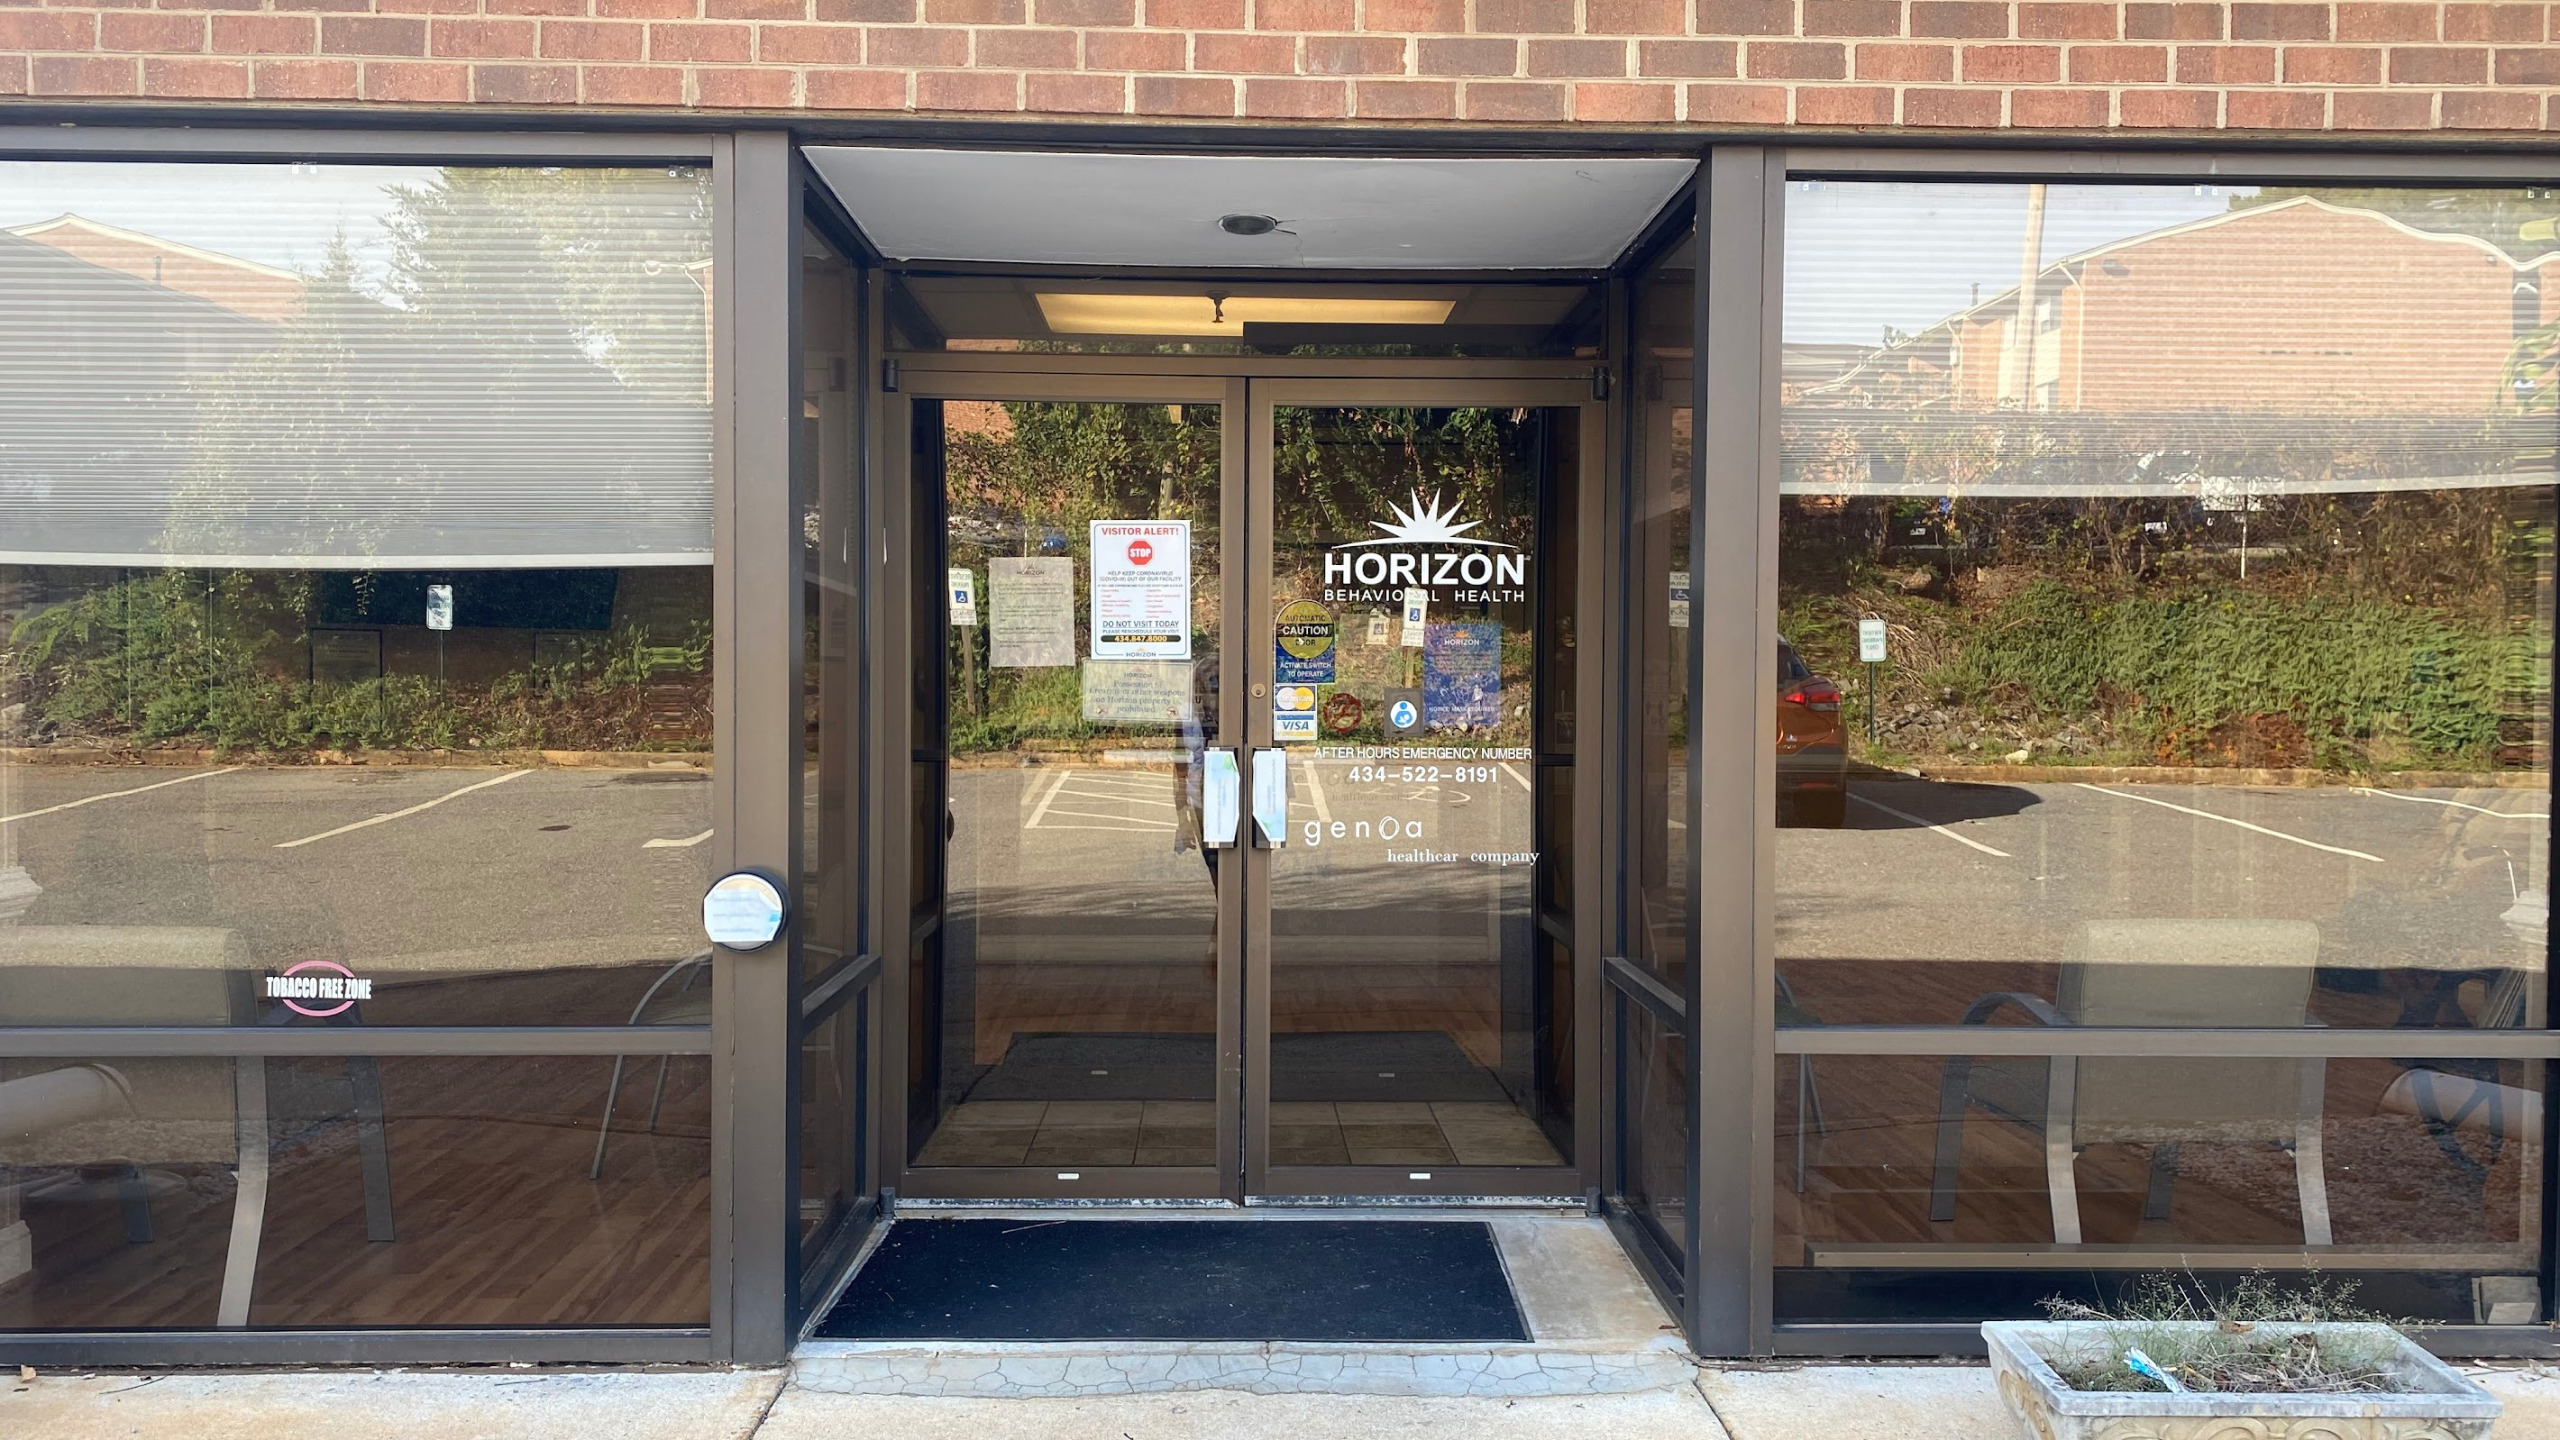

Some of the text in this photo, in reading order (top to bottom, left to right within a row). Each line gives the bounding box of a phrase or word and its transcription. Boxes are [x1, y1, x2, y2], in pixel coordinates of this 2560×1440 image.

[1101, 527, 1179, 536] VISITOR ALERT!
[1129, 548, 1152, 558] STOP
[1324, 553, 1525, 585] HORIZON
[1324, 589, 1440, 602] BEHAVIOAL
[1455, 589, 1525, 602] HEALTH
[1102, 620, 1180, 628] DO NOT VISIT TODAY
[1282, 625, 1329, 635] CAUTION
[1280, 661, 1332, 669] ACTIVATE SWITCH
[1281, 721, 1309, 730] VISA
[1314, 746, 1532, 759] AFTER HOURS EMERGENCY NUMBER
[1349, 766, 1498, 783] 434-522-8191
[1386, 848, 1541, 867] healthcar company
[266, 976, 372, 999] TOBACCO FREE ZONE
